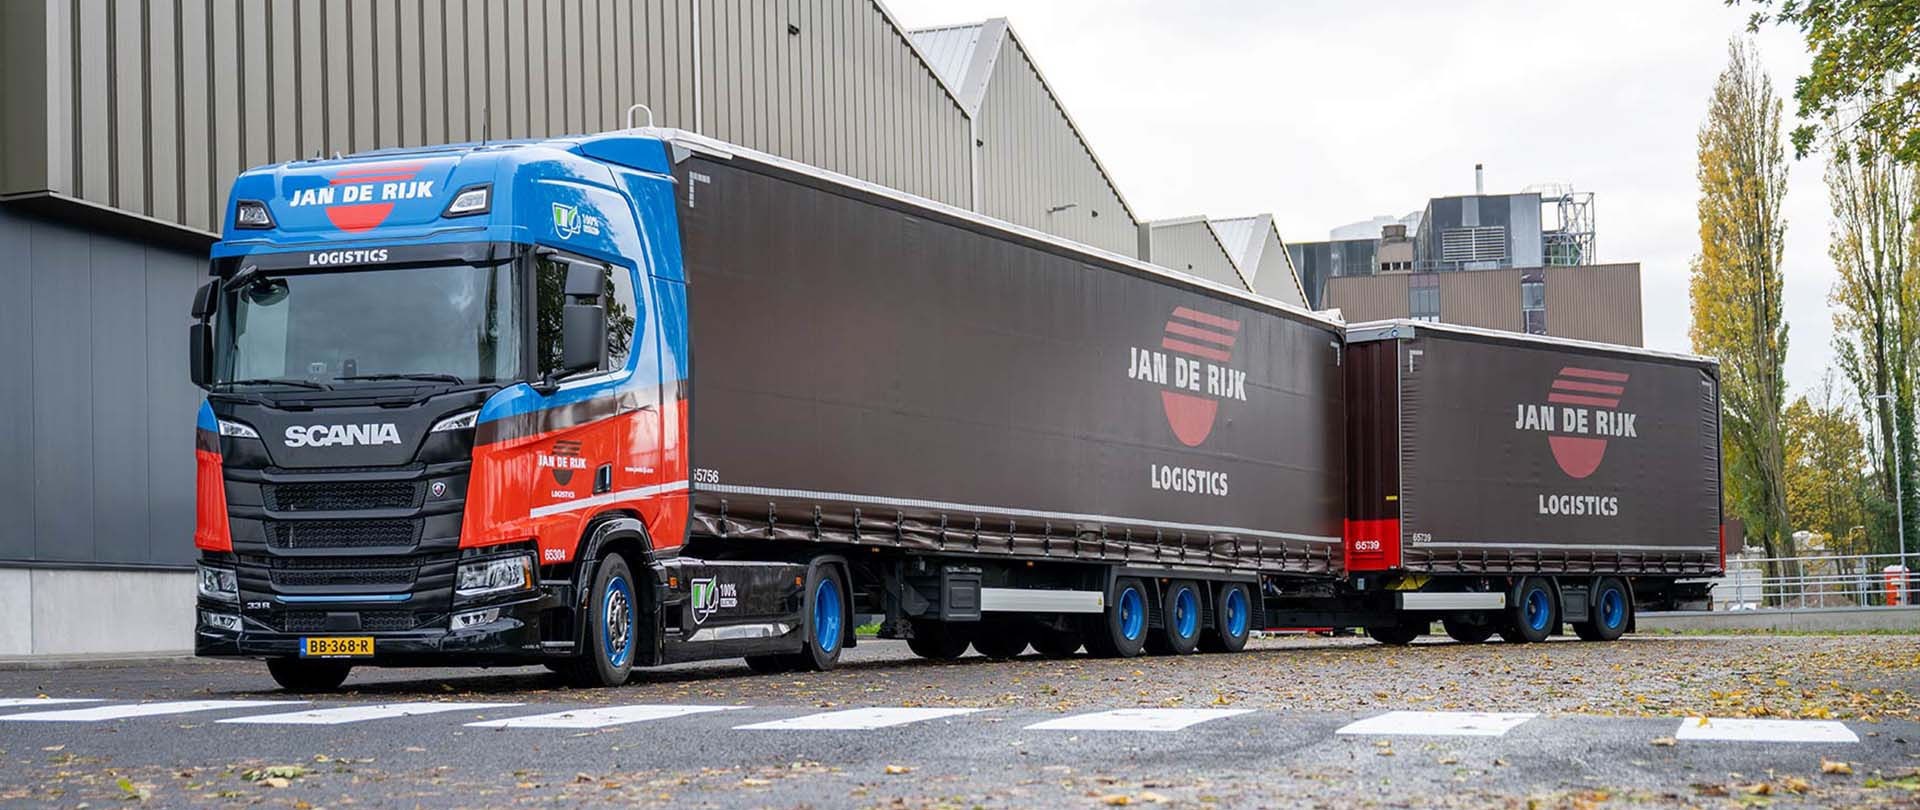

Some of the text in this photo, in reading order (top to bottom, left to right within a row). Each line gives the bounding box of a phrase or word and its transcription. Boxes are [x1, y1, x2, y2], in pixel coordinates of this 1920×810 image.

[290, 180, 434, 207] JAN DE RIJK
[309, 249, 388, 265] LOGISTICS
[1128, 347, 1247, 401] JAN DE RIJK
[1515, 404, 1638, 438] JAN DE RIJK
[284, 423, 402, 448] SCANIA
[538, 454, 587, 469] JAN DE RIJK
[1151, 464, 1229, 497] LOGISTICS
[551, 490, 576, 499] LOGISTICS
[1538, 494, 1618, 516] LOGISTICS
[1412, 532, 1432, 542] 65739
[1355, 540, 1380, 550] 65739
[544, 548, 566, 561] 65304
[720, 583, 737, 597] 100%
[310, 640, 369, 653] BB-368-R
